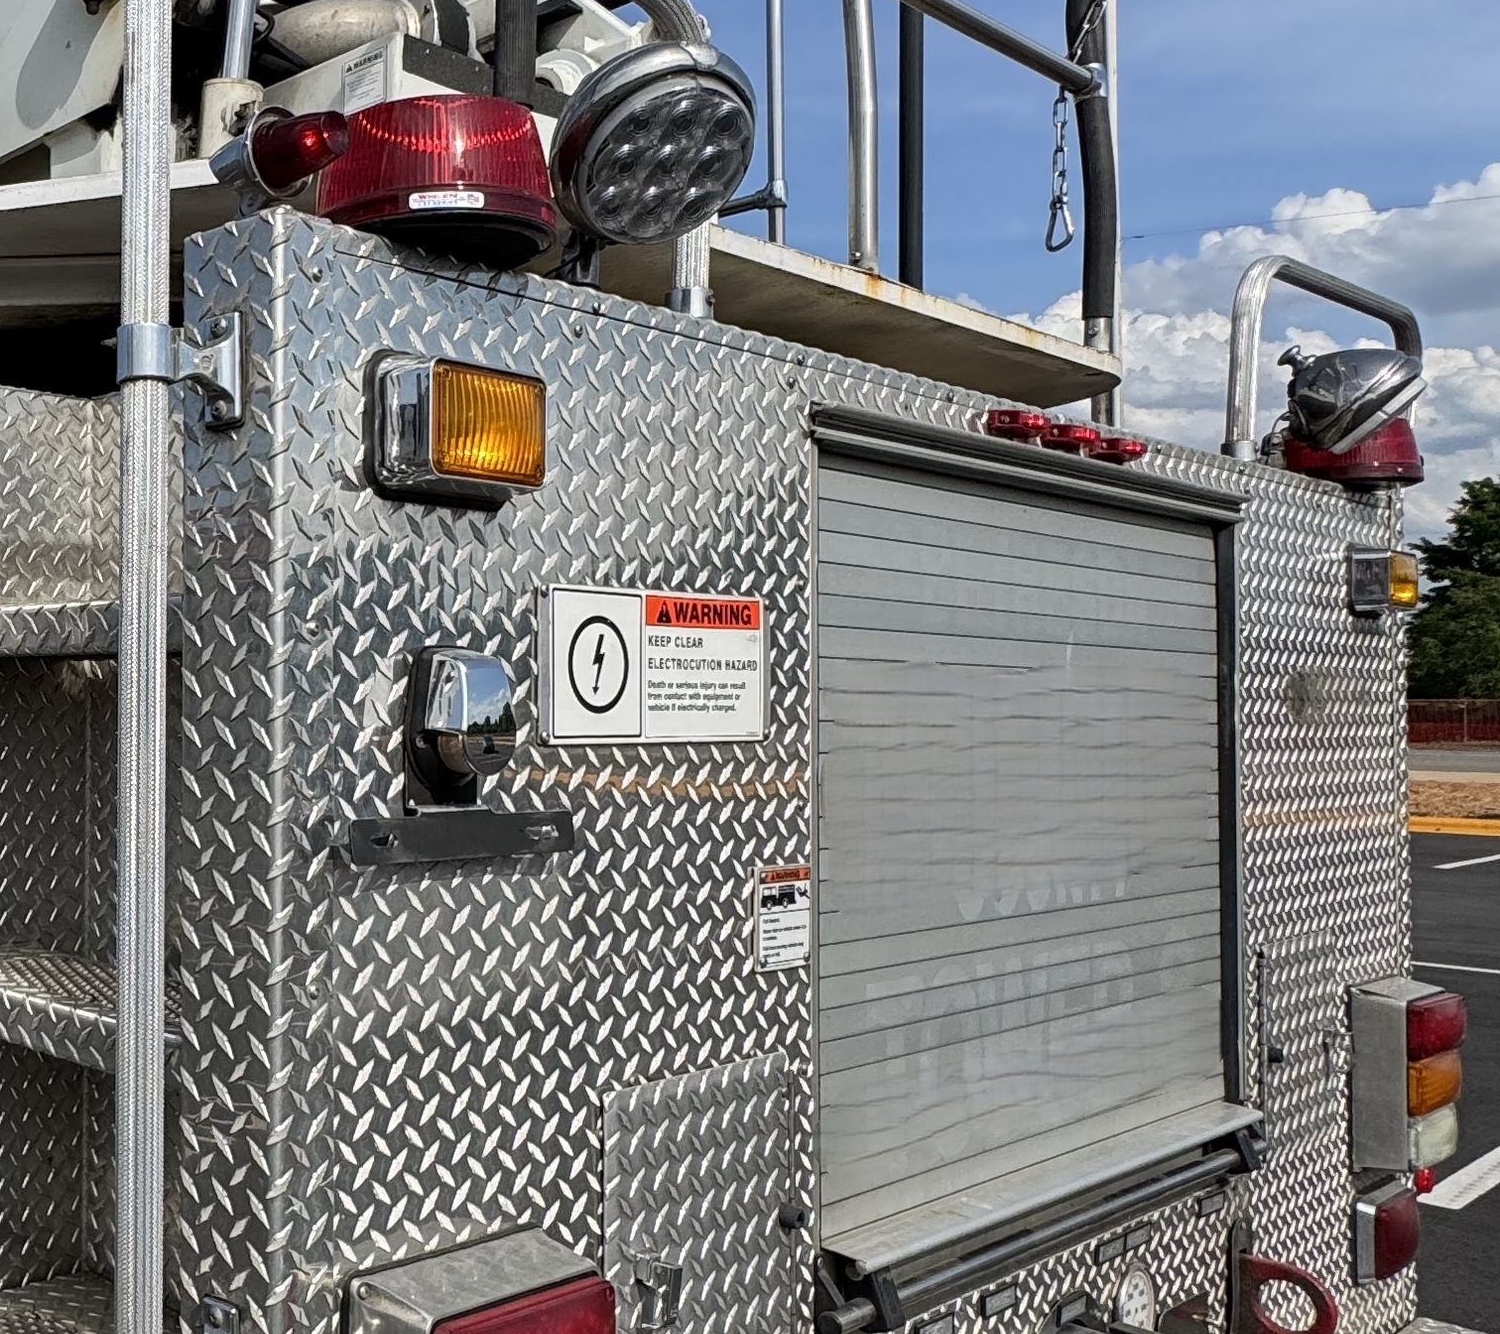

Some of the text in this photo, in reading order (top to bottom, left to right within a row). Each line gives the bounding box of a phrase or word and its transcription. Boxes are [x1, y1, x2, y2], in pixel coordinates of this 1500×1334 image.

[673, 601, 752, 626] WARNING
[647, 634, 704, 649] KEEP CLEAR
[647, 657, 758, 672] ELECTROCUTION HAZARD
